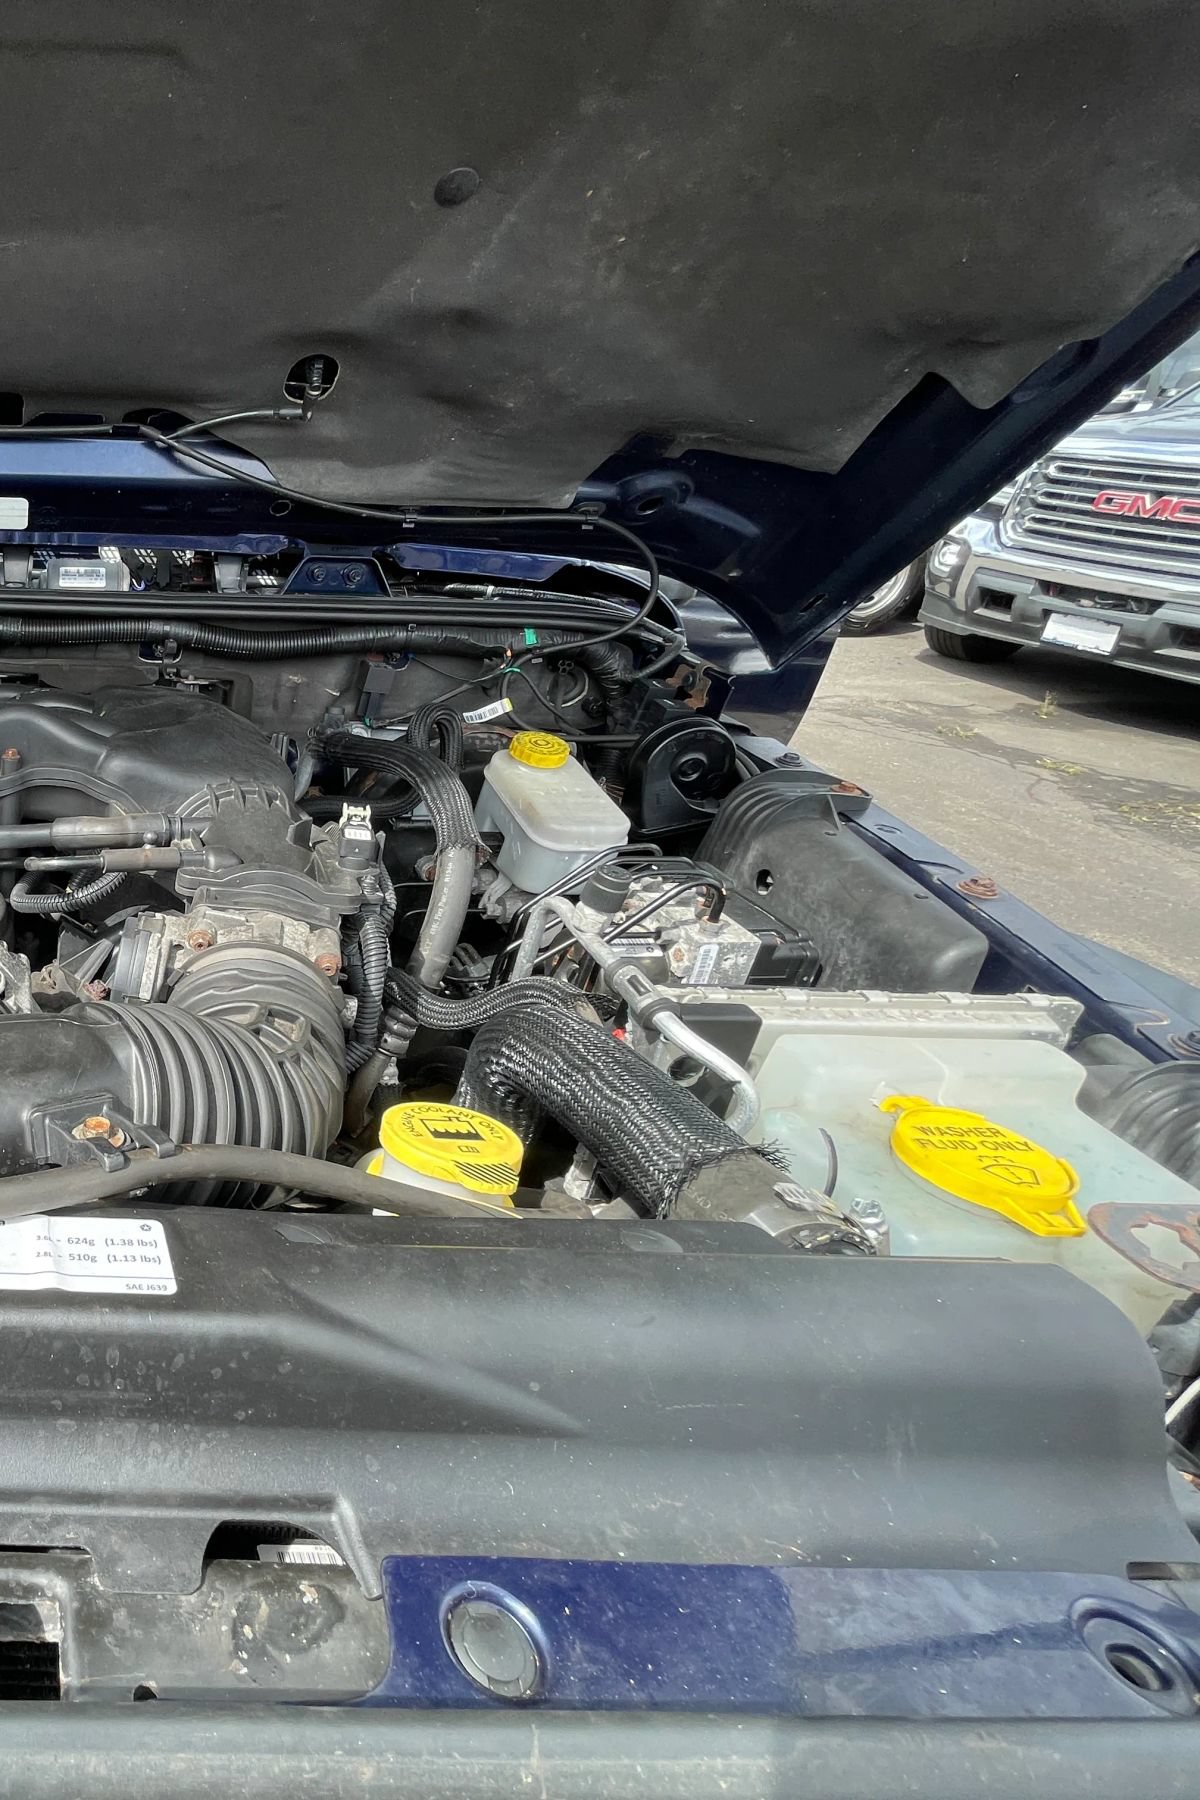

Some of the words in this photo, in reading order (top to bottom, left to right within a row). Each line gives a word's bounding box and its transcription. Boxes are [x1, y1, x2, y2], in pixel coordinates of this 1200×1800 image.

[1092, 490, 1200, 524] GMC
[411, 1105, 476, 1121] COOLANT
[912, 1125, 1006, 1139] WASHER
[915, 1138, 978, 1152] FLUID
[979, 1140, 1036, 1153] ONLY
[67, 1237, 95, 1246] 624g
[104, 1238, 134, 1247] (1.38
[137, 1239, 158, 1248] lbs)
[68, 1253, 98, 1263] 510g
[107, 1254, 137, 1264] (1.13
[140, 1255, 161, 1265] lbs)
[125, 1283, 144, 1291] SAE
